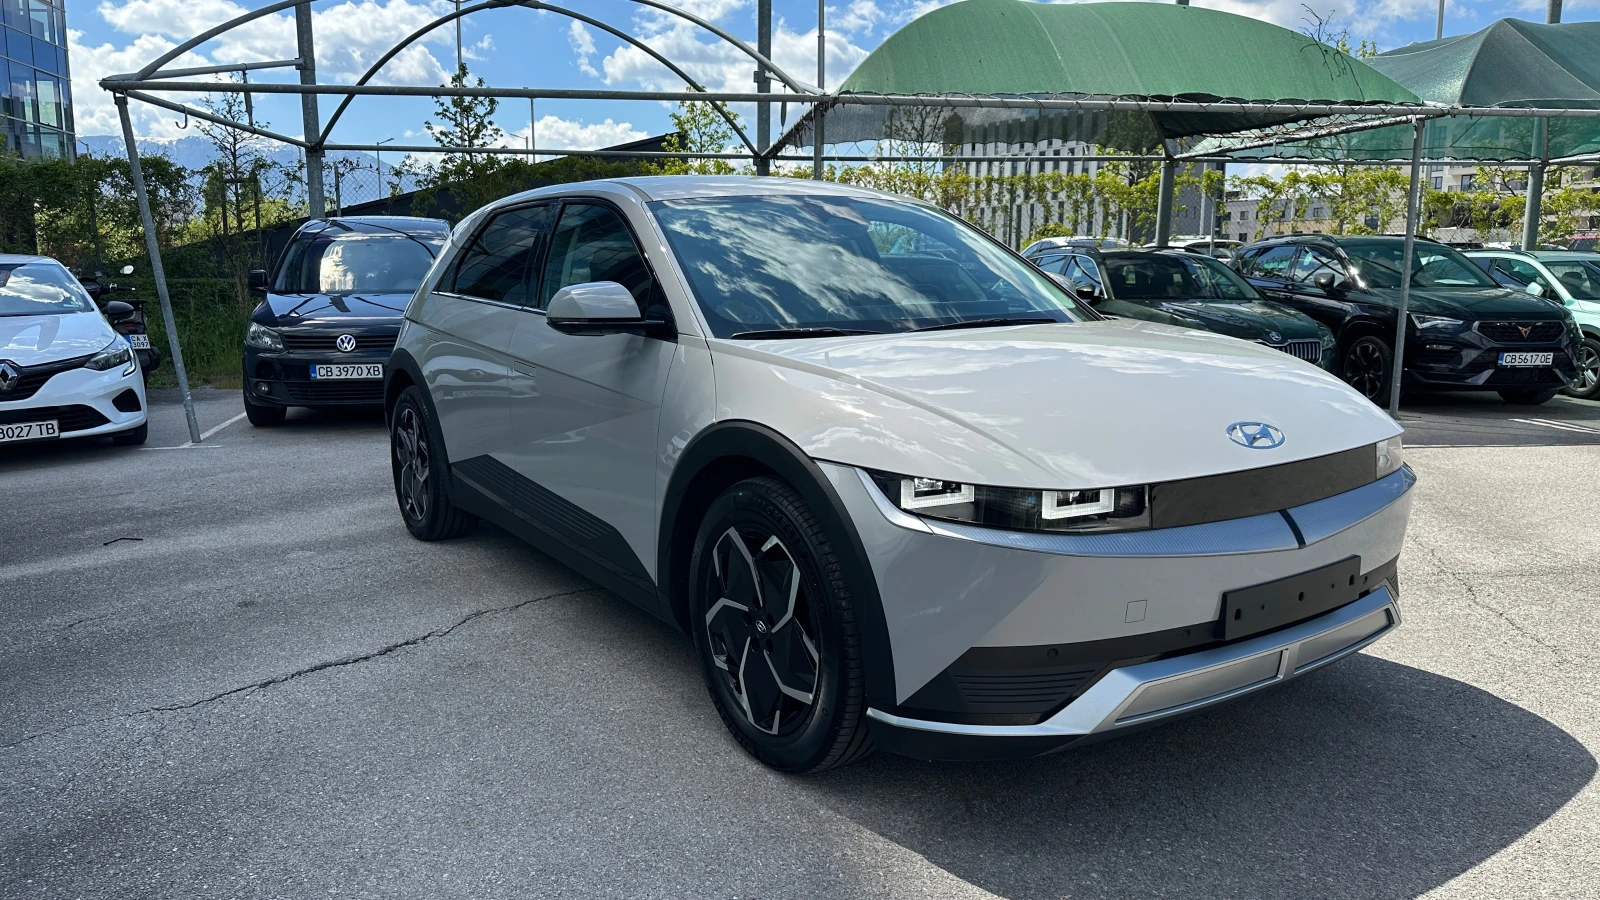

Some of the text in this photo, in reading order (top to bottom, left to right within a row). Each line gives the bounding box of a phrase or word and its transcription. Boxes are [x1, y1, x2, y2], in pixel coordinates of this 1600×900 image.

[1504, 354, 1517, 364] CB
[1517, 354, 1539, 364] 5617
[318, 366, 333, 377] CB
[335, 366, 363, 377] 3970
[365, 365, 380, 377] XB
[36, 423, 56, 436] TB
